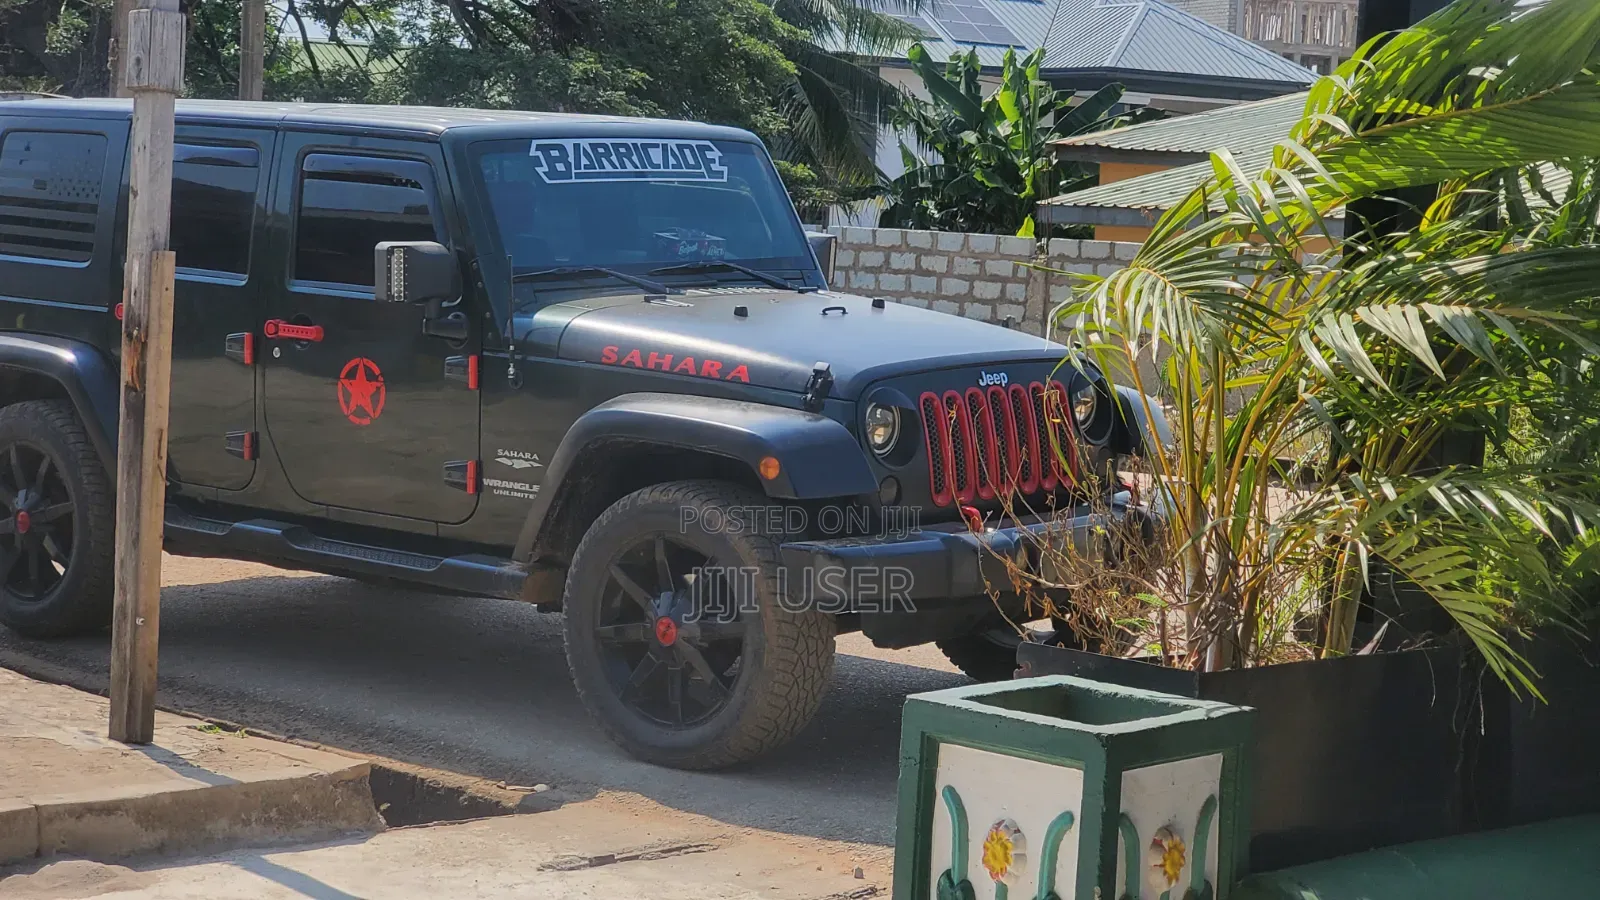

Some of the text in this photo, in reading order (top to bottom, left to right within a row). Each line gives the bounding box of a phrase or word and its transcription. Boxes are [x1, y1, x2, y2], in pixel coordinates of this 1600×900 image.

[530, 138, 728, 184] BARRICADE
[601, 345, 750, 383] SAHARA
[978, 370, 1009, 388] Jeep
[497, 448, 540, 461] SAHARA
[482, 478, 541, 492] WRANGLE
[493, 489, 537, 500] UNLIMITE
